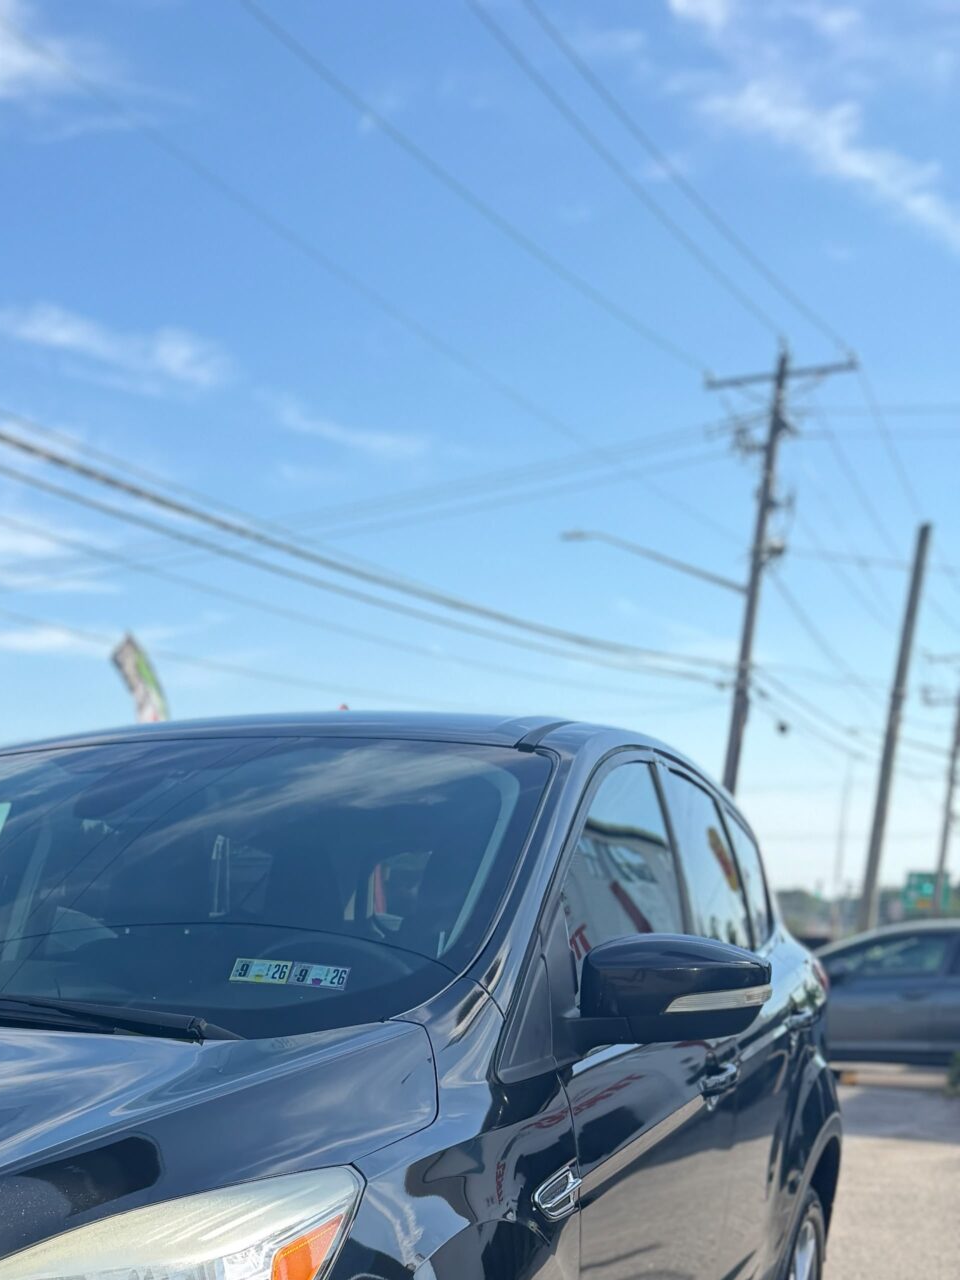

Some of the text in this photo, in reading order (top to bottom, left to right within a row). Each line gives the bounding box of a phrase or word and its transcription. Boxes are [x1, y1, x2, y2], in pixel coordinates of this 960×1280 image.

[238, 963, 250, 977] 9
[271, 963, 289, 980] 26
[296, 968, 309, 983] 9
[329, 968, 347, 986] 26
